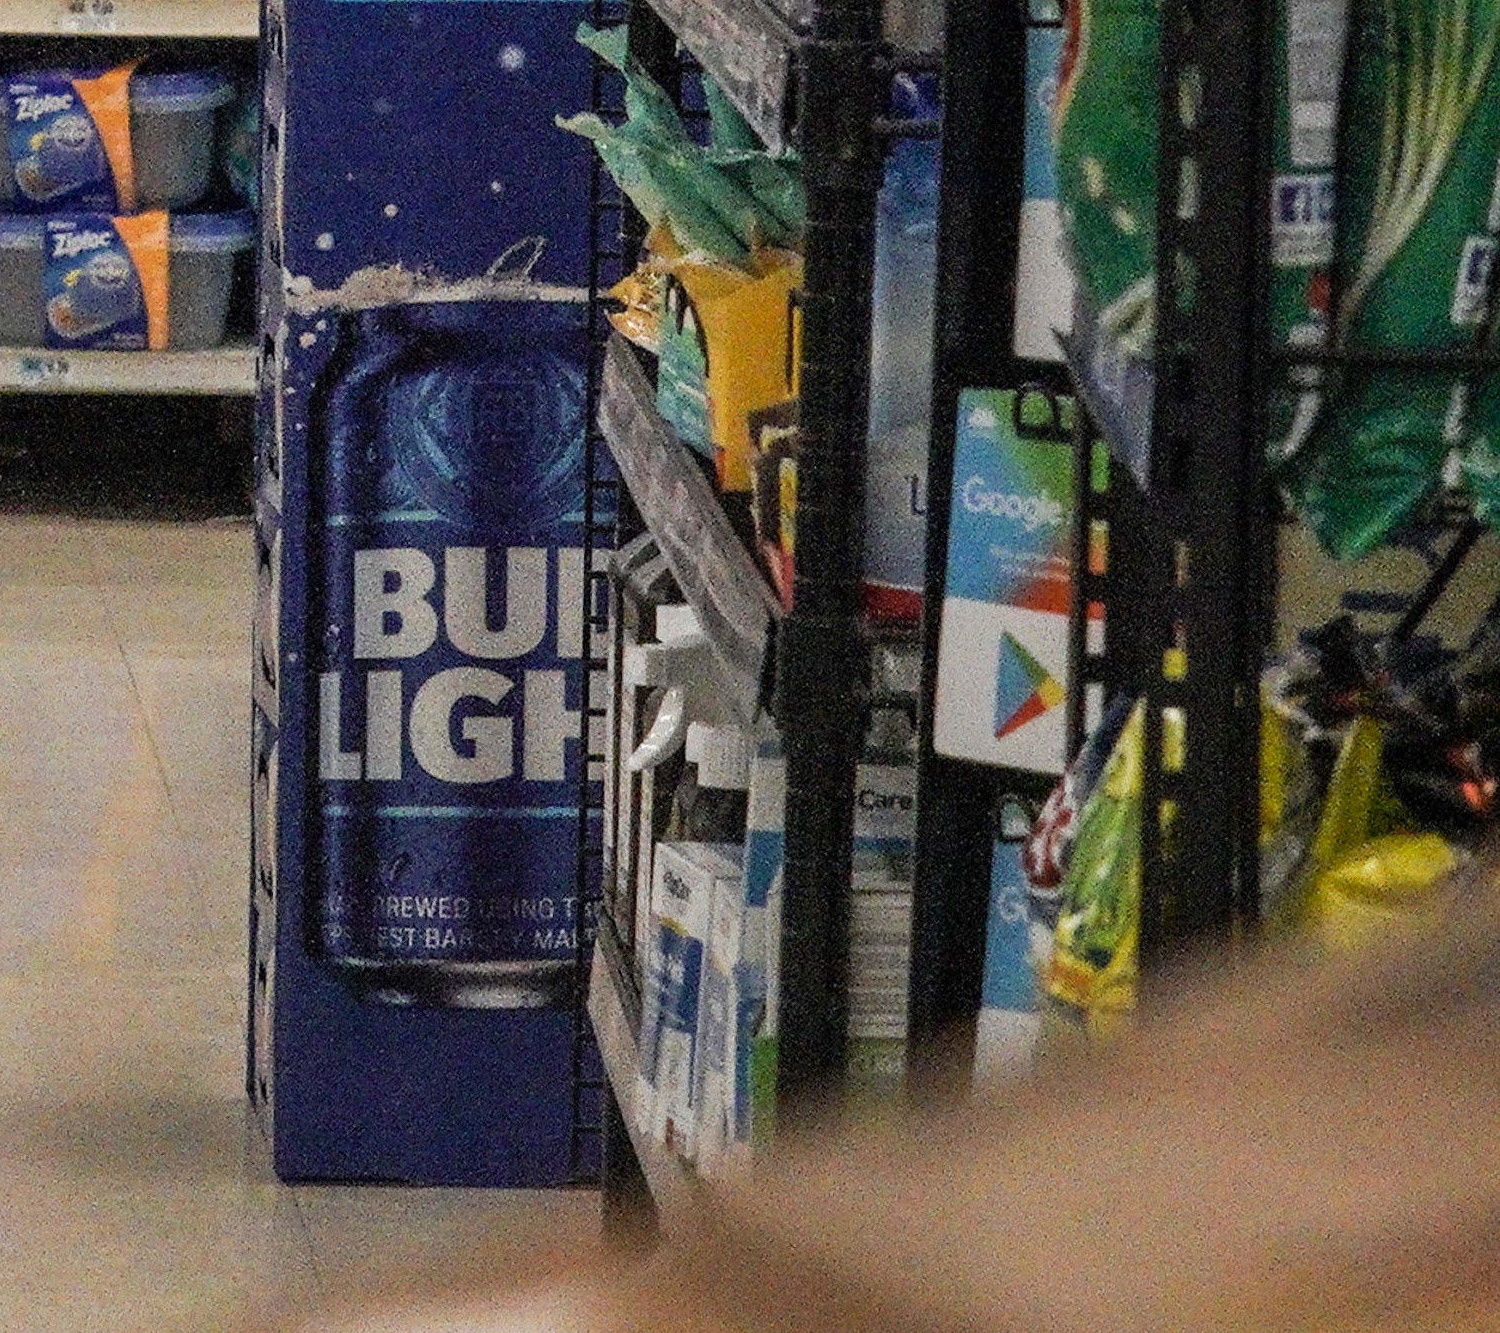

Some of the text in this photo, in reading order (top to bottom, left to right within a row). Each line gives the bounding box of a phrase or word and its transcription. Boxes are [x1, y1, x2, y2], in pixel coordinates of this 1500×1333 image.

[14, 93, 74, 123] Ziploc
[52, 230, 112, 259] Ziploc
[318, 665, 606, 785] LIGH
